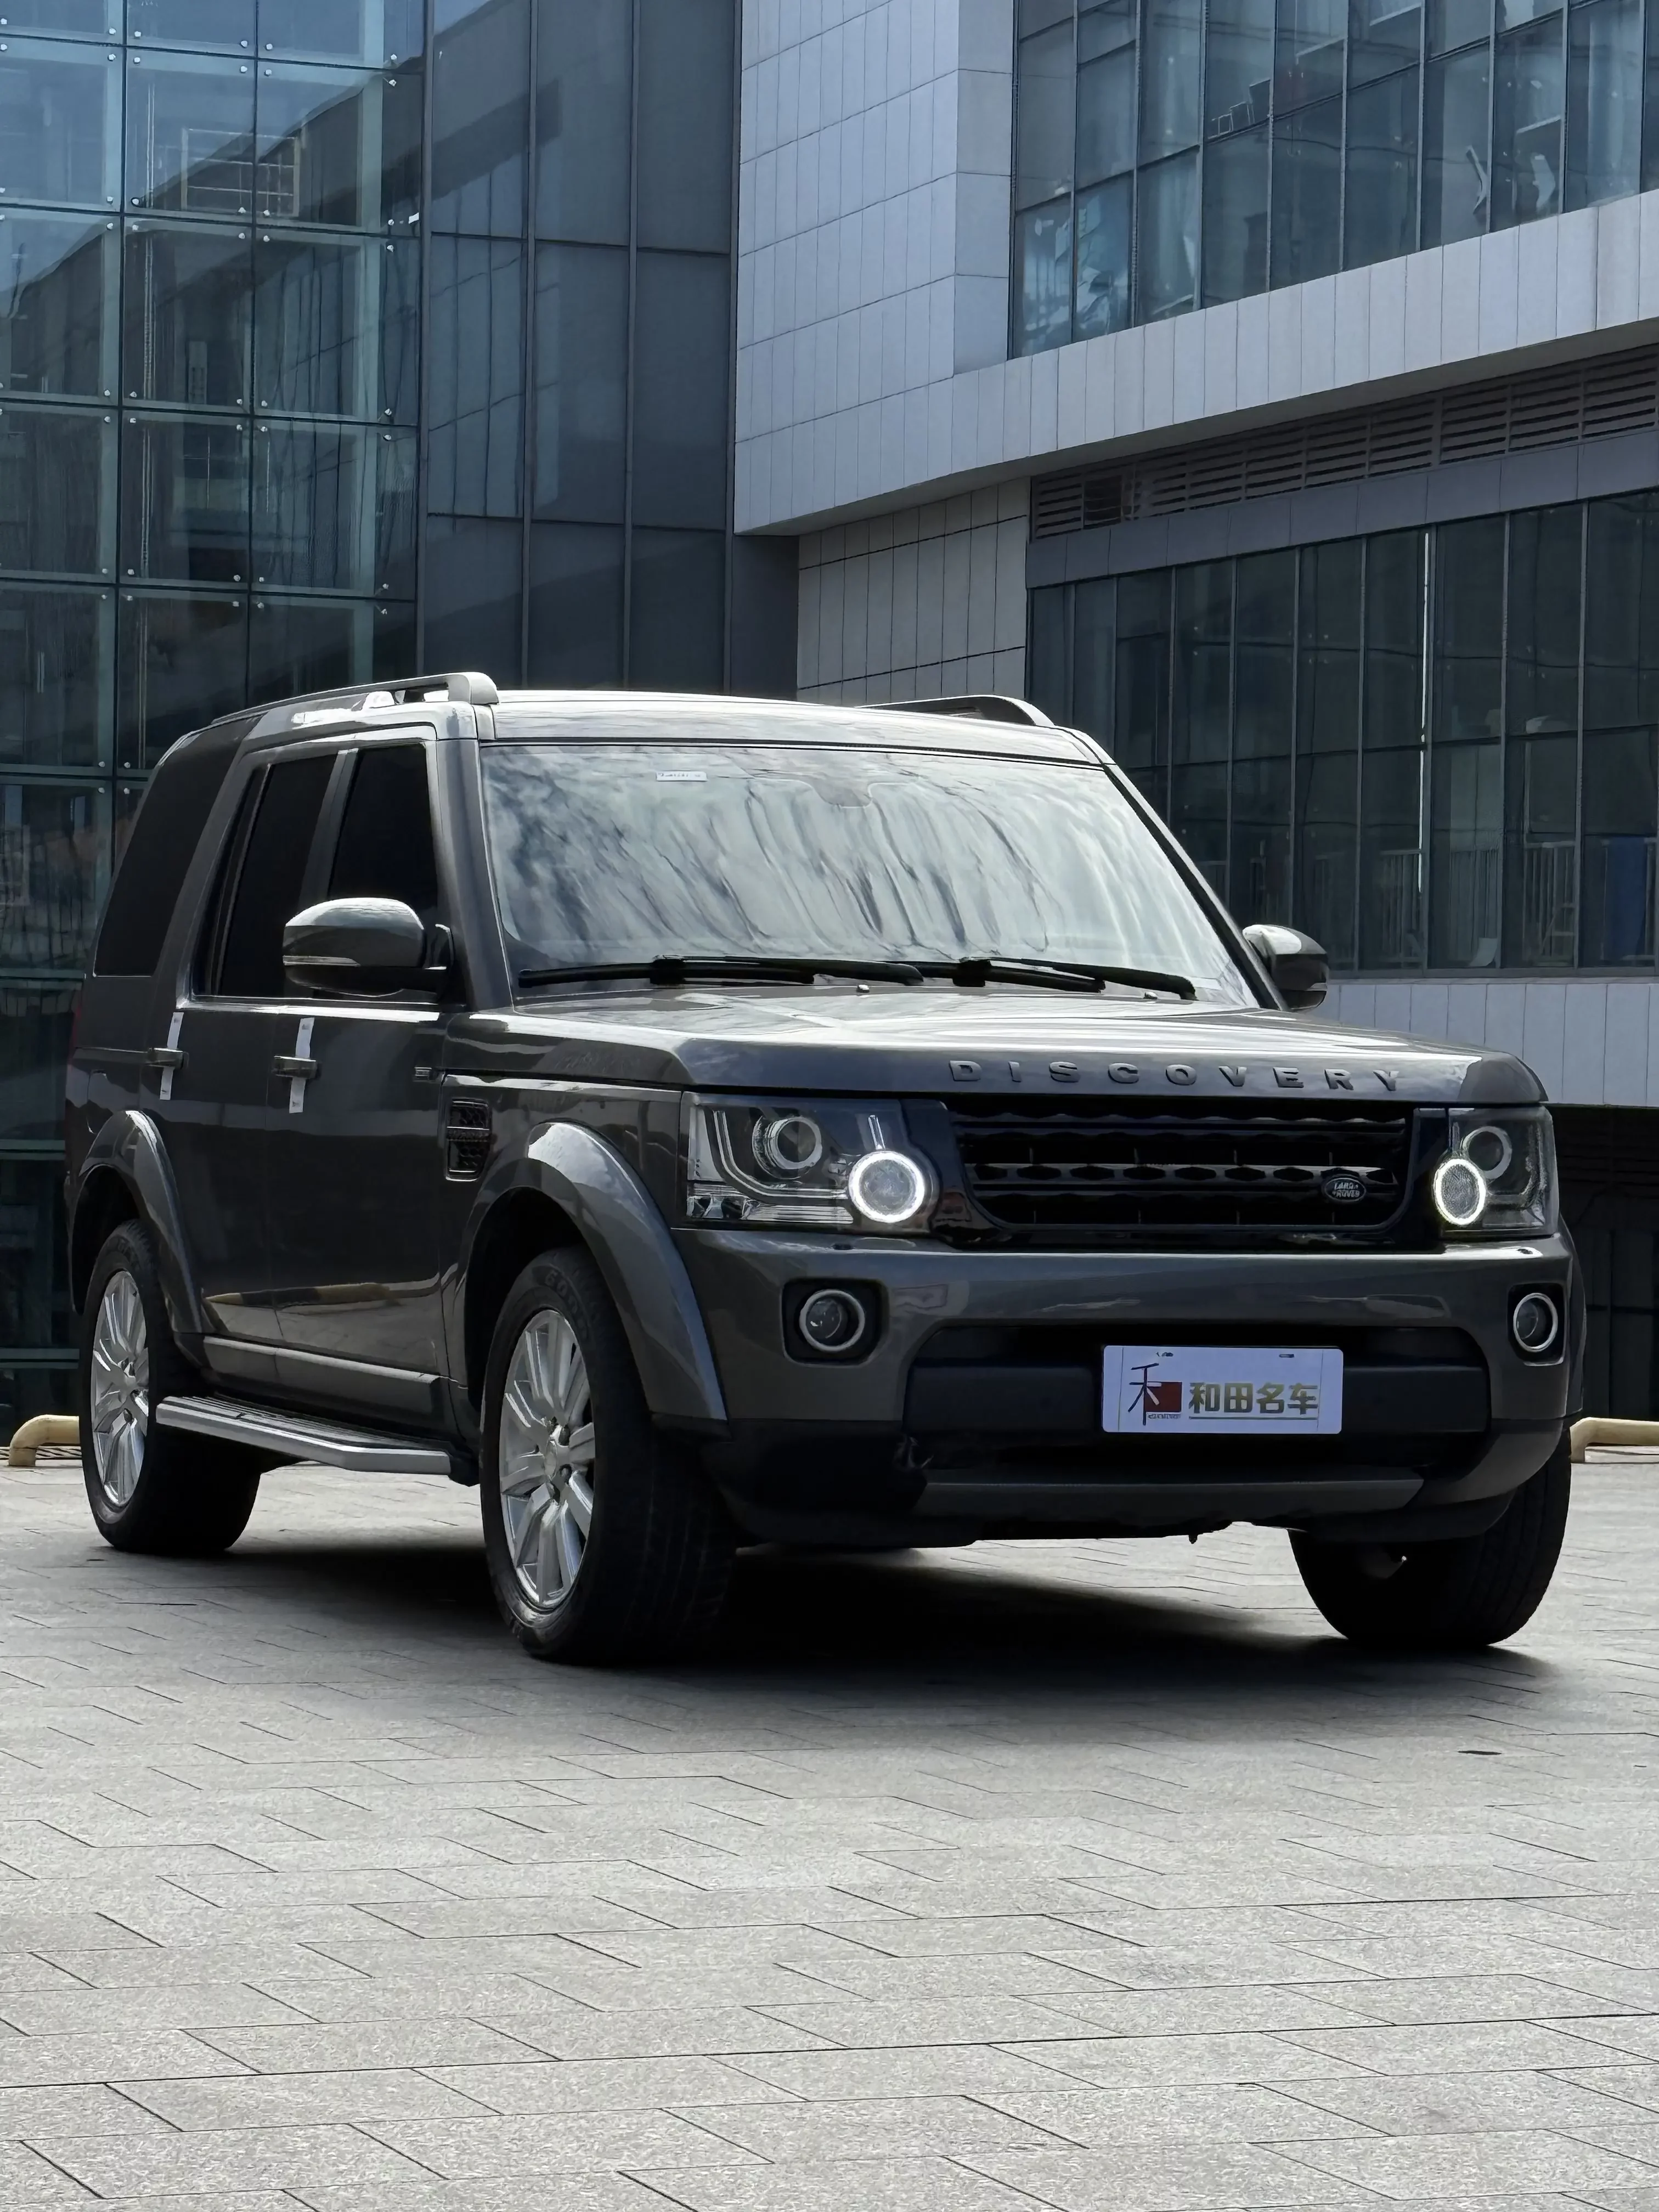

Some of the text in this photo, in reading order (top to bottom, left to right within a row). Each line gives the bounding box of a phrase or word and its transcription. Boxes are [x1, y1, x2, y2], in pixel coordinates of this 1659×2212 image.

[949, 1060, 1400, 1092] DISCOVERY
[1188, 1382, 1318, 1415] 和田名车
